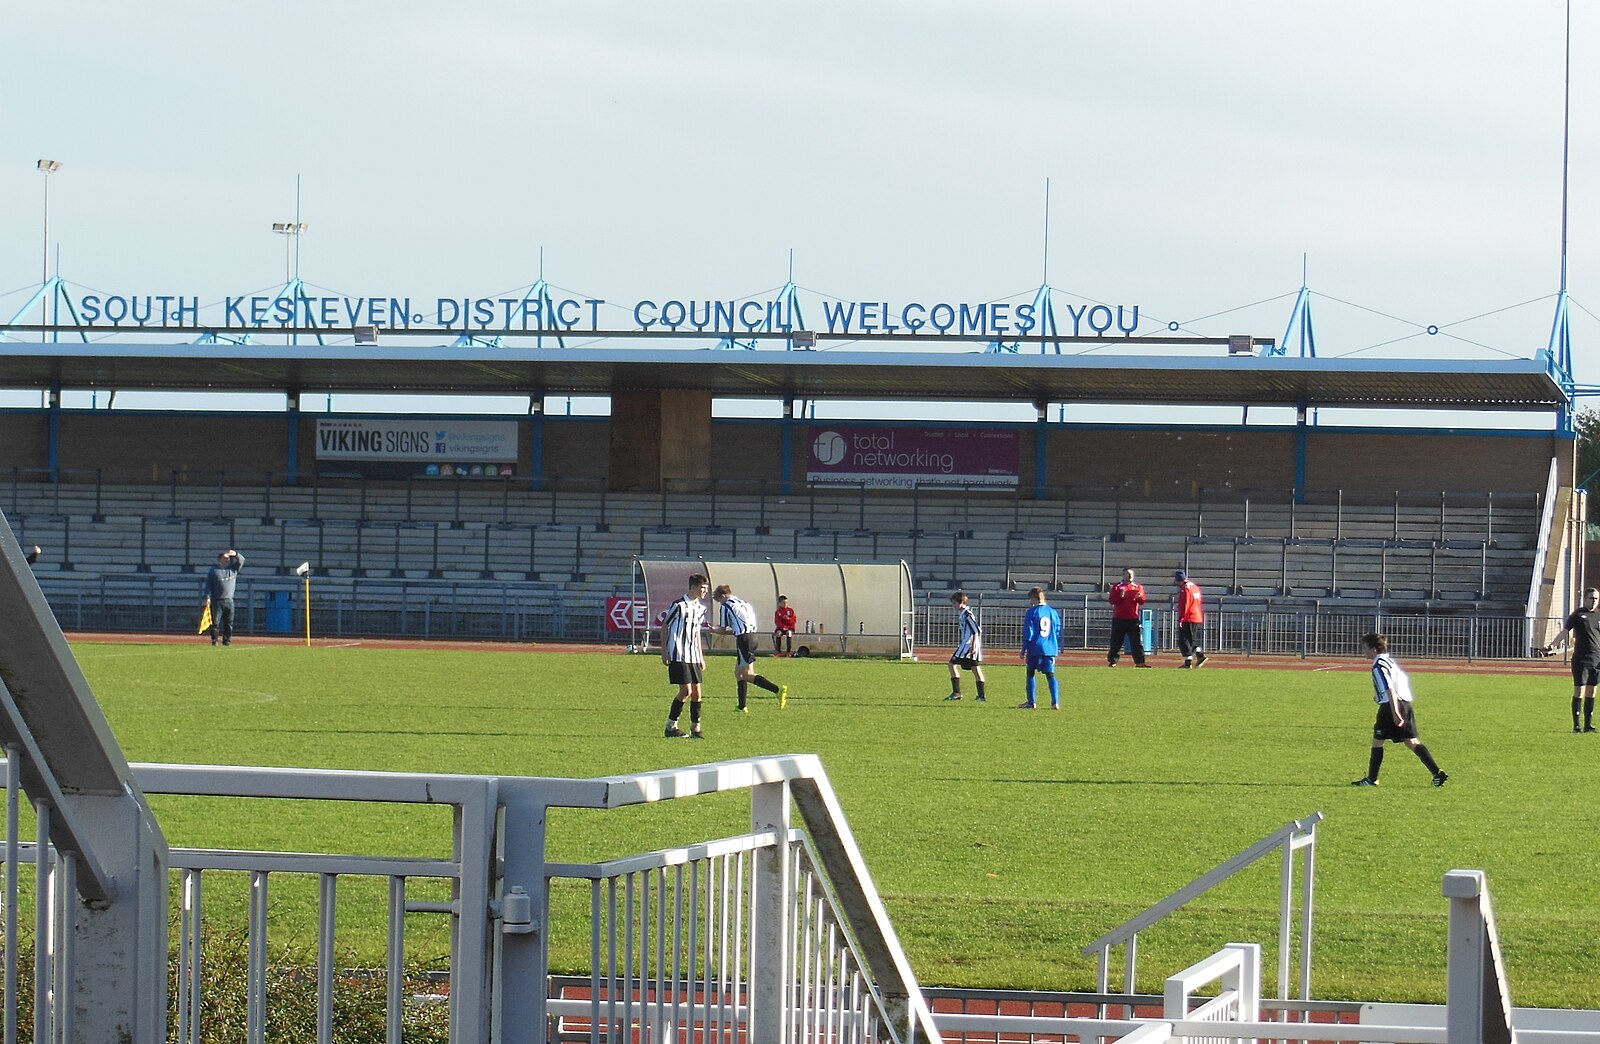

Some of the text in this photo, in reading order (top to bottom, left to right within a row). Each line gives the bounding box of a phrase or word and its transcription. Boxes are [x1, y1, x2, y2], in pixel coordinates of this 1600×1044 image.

[80, 296, 1139, 333] SOUTH KESTEVEN DISTRICT COUNCIL WELCOMES YOU
[320, 430, 430, 453] VIKING SIGNS
[448, 432, 505, 442] @vikingsigns
[853, 431, 894, 449] total
[449, 443, 499, 454] vikingsigns
[853, 448, 954, 473] networking
[1039, 616, 1051, 638] 9
